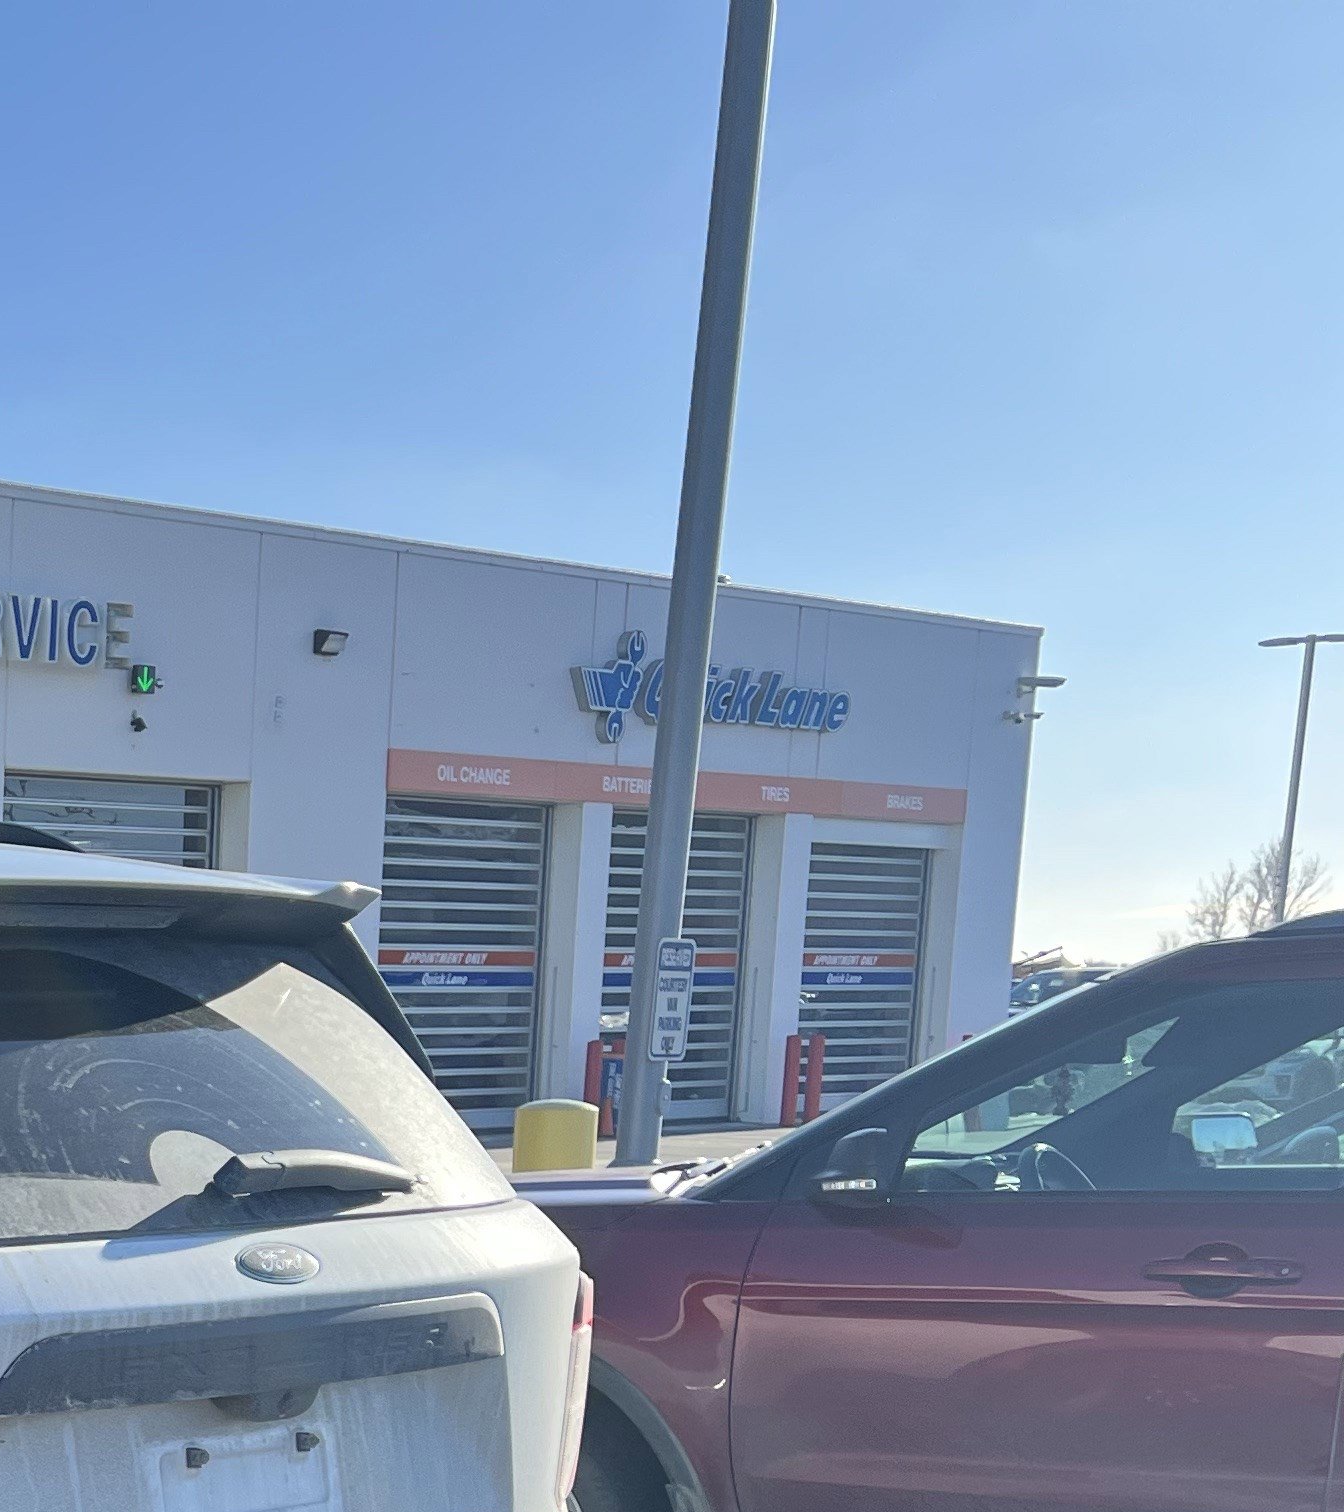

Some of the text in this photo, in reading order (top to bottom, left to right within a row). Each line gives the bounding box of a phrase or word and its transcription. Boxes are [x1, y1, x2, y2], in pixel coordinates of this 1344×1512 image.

[639, 659, 852, 733] ick Lane
[437, 764, 511, 786] OIL CHANGE
[603, 776, 652, 794] BATTERIE
[761, 786, 790, 802] TIRES
[887, 794, 924, 811] BRAKES
[402, 951, 489, 965] APPOINTMENT ONLY
[422, 972, 469, 986] Quick Lane
[255, 1248, 303, 1273] Ford
